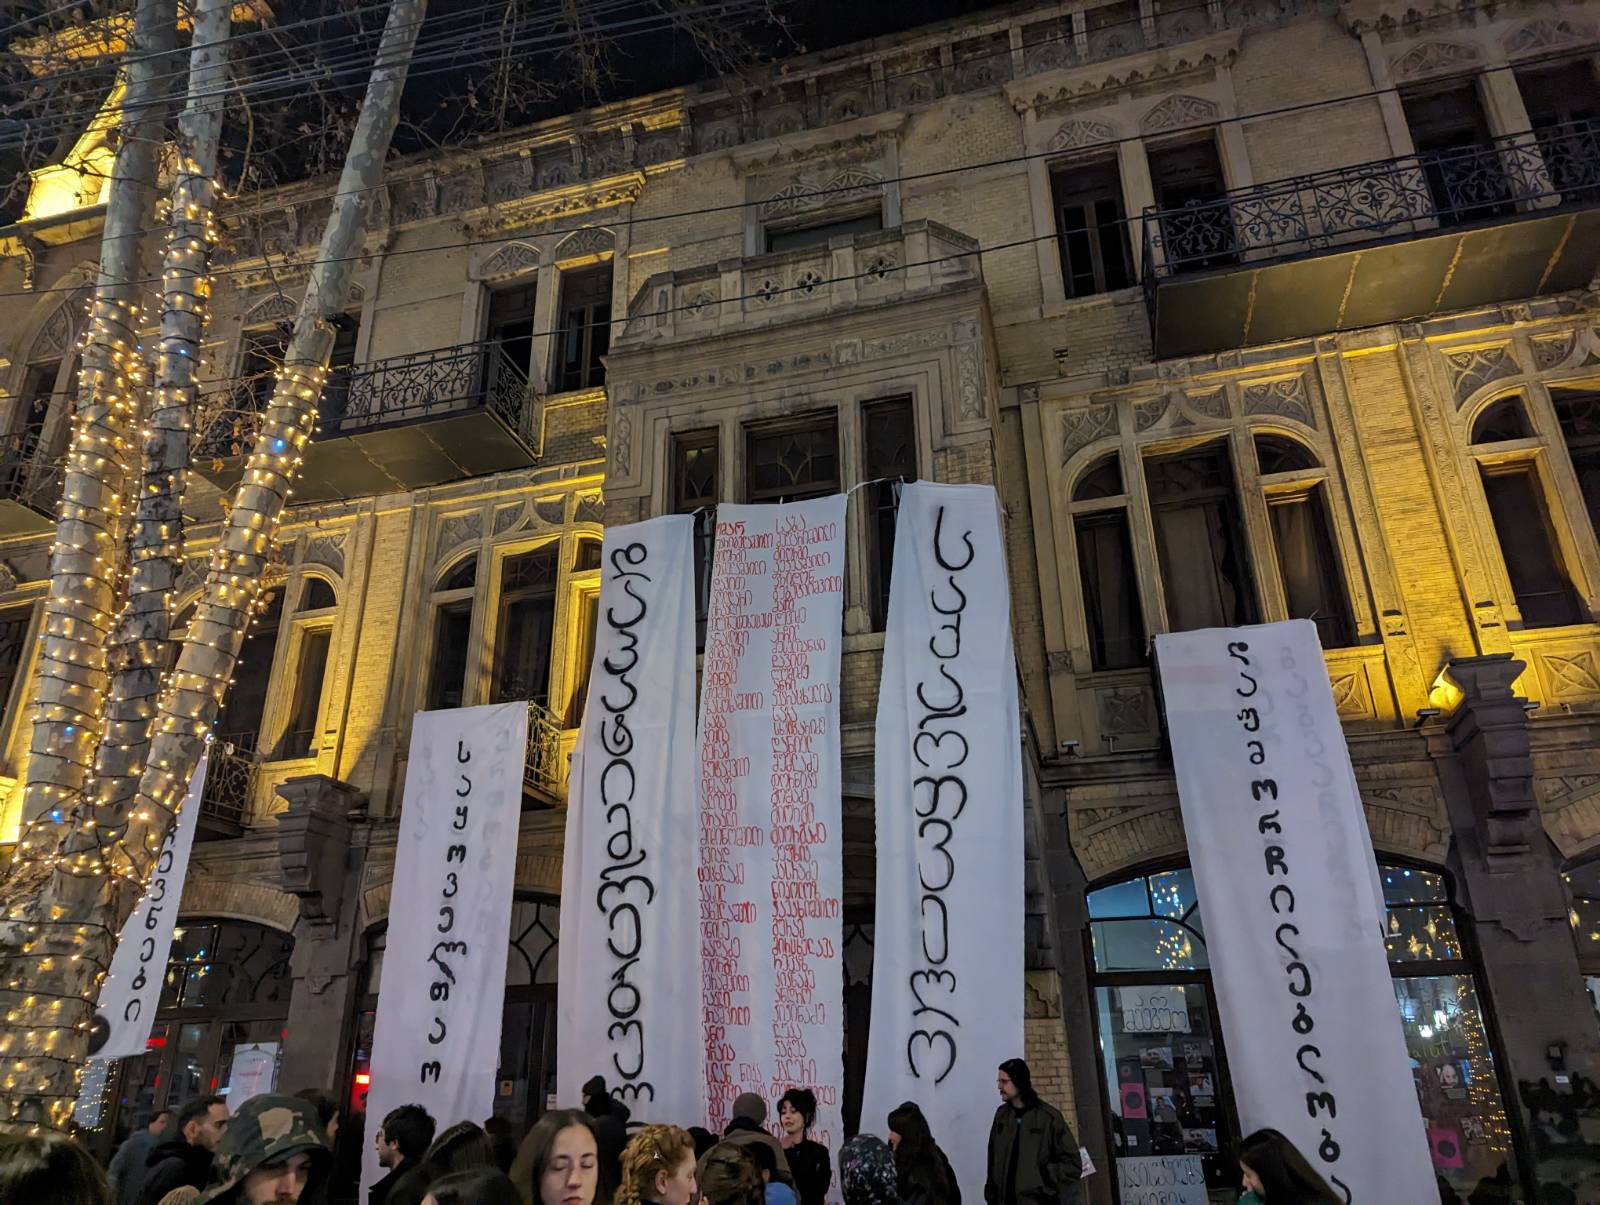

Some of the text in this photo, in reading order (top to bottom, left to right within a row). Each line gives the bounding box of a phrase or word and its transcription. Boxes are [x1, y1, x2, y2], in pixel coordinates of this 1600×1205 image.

[771, 652, 808, 668] დავით
[906, 505, 975, 1088] საქართველო
[420, 740, 472, 1084] საყოველთაო
[773, 1022, 802, 1040] ლუკა
[771, 1058, 817, 1083] ვალერი
